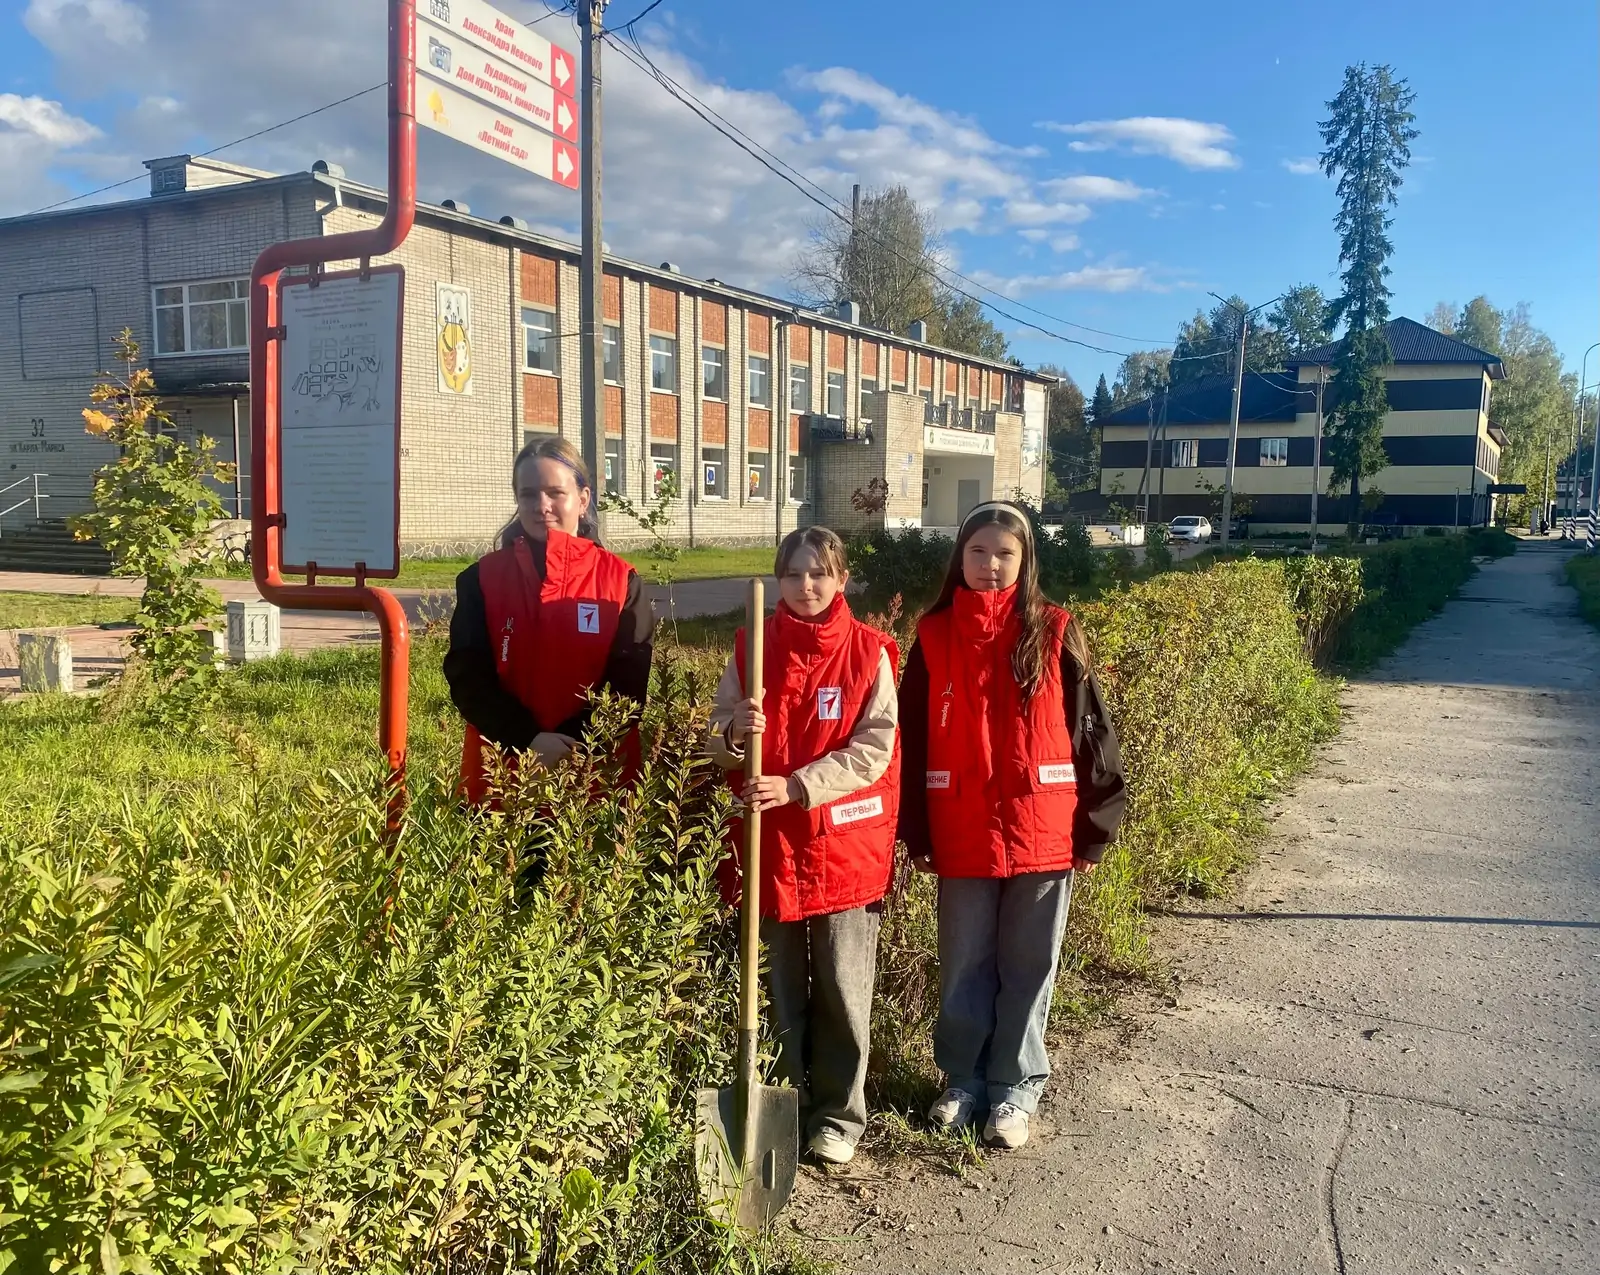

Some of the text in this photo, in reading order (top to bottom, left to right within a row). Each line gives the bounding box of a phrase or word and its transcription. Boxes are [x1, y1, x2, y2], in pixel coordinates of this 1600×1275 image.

[495, 18, 515, 38] Храм
[462, 17, 543, 71] Александра Невского
[484, 63, 527, 93] Пудожский
[456, 66, 551, 121] Дом культуры, кинотеатр
[494, 120, 514, 137] Парк
[478, 131, 529, 160] «Летний сад»
[31, 418, 45, 438] 32
[840, 803, 878, 818] ПЕРВЫХ
